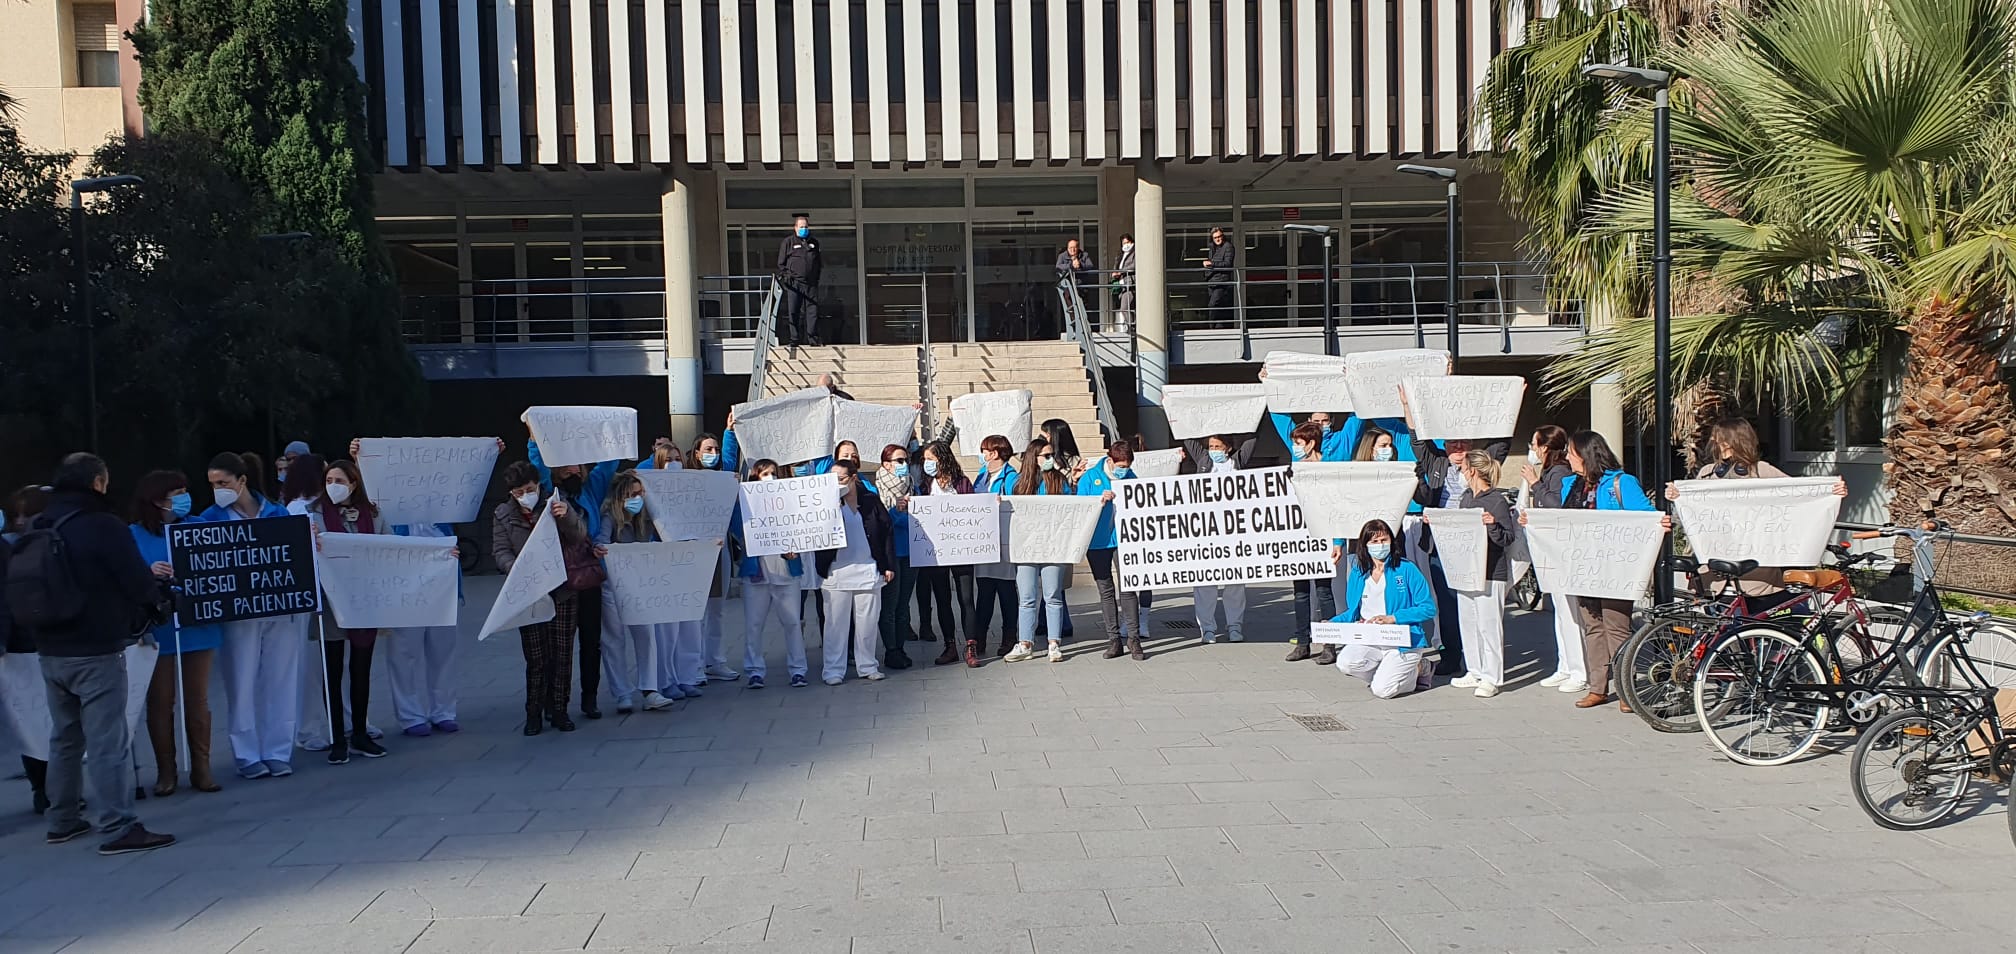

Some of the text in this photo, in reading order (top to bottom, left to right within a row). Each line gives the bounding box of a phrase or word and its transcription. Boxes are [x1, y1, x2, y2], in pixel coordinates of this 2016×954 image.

[870, 245, 906, 254] HOSPITAL
[1491, 381, 1512, 393] EN
[1441, 397, 1504, 410] PLANTILLA
[743, 476, 828, 495] VOCACIÓN
[1123, 471, 1288, 510] POR LA MEJORA EN
[1683, 487, 1712, 502] POR
[397, 490, 481, 512] ESPERA
[763, 492, 823, 512] NO ES
[750, 508, 838, 529] EXPLOTACIÓN
[1680, 504, 1796, 522] DIGNA Y DE
[1120, 504, 1307, 543] ASISTENCIA DE CALID
[1555, 516, 1658, 545] ENFERMERIA
[1685, 521, 1791, 537] CALIDAD EN
[174, 524, 257, 548] PERSONAL
[753, 526, 824, 540] QUE MI CANSANCIO
[781, 532, 841, 552] SALPIQUE
[914, 533, 928, 543] LA
[925, 547, 944, 557] NOS
[1123, 535, 1328, 566] en los servicios de urgencias
[1561, 546, 1640, 563] COLAPSO
[1701, 540, 1801, 556] URGENCIAS
[670, 551, 696, 564] NO
[1124, 560, 1332, 588] NO A LA REDUCCION DE PERSONAL
[1576, 564, 1602, 576] EN
[250, 569, 295, 590] PARA
[639, 572, 673, 589] LOS
[1558, 575, 1647, 592] URGENCIAS
[195, 600, 223, 620] LOS
[620, 590, 704, 614] RECORTES
